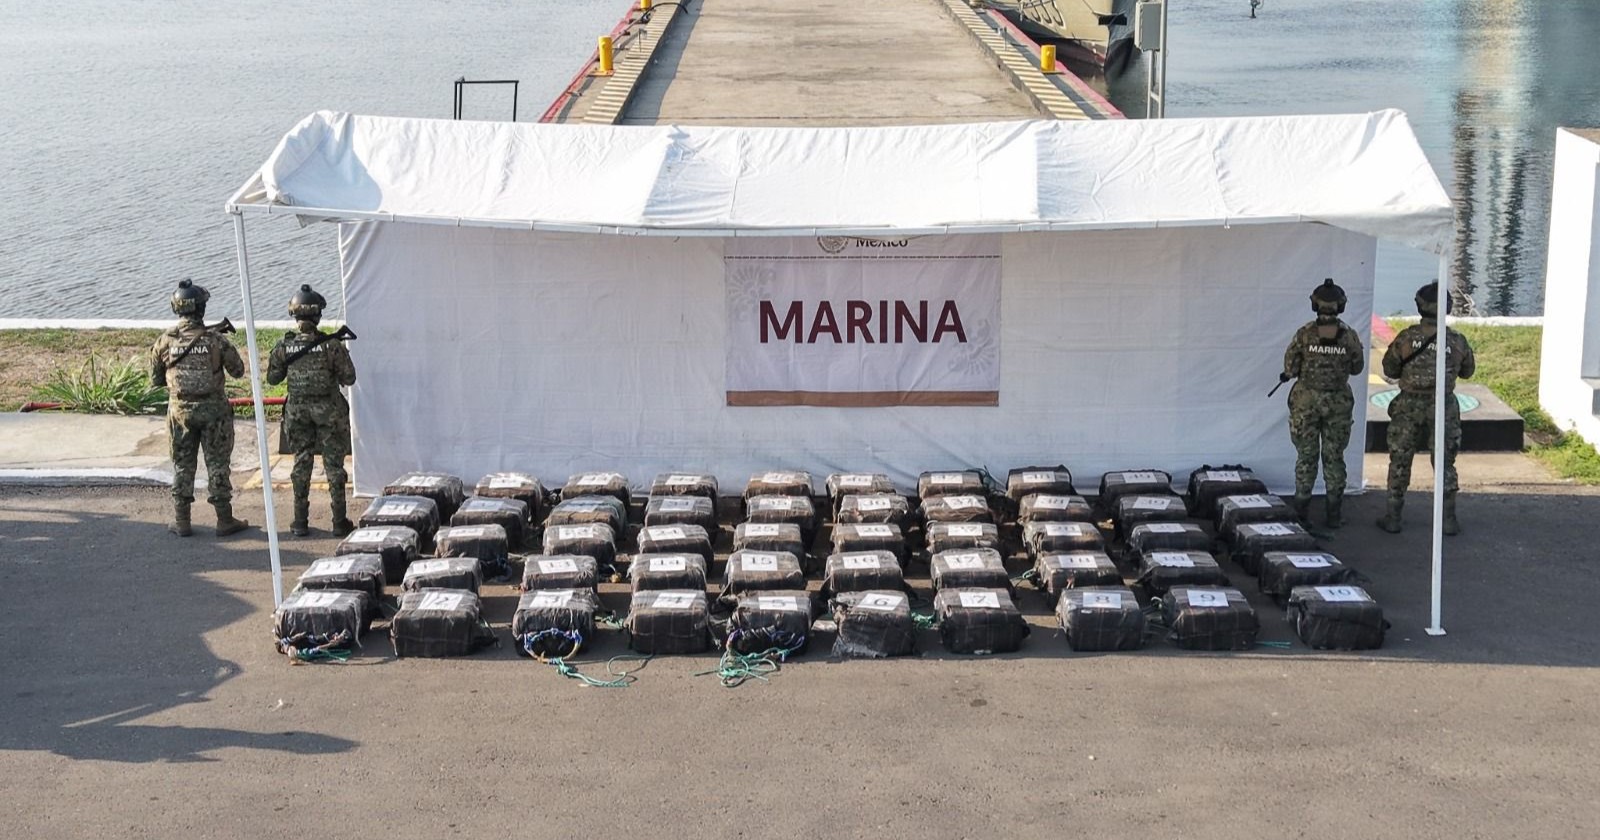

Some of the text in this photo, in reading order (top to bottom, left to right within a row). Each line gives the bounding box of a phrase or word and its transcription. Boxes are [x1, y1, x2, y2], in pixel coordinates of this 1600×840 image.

[759, 300, 968, 343] MARINA
[170, 346, 209, 355] MAINA
[1309, 344, 1346, 354] MARINA
